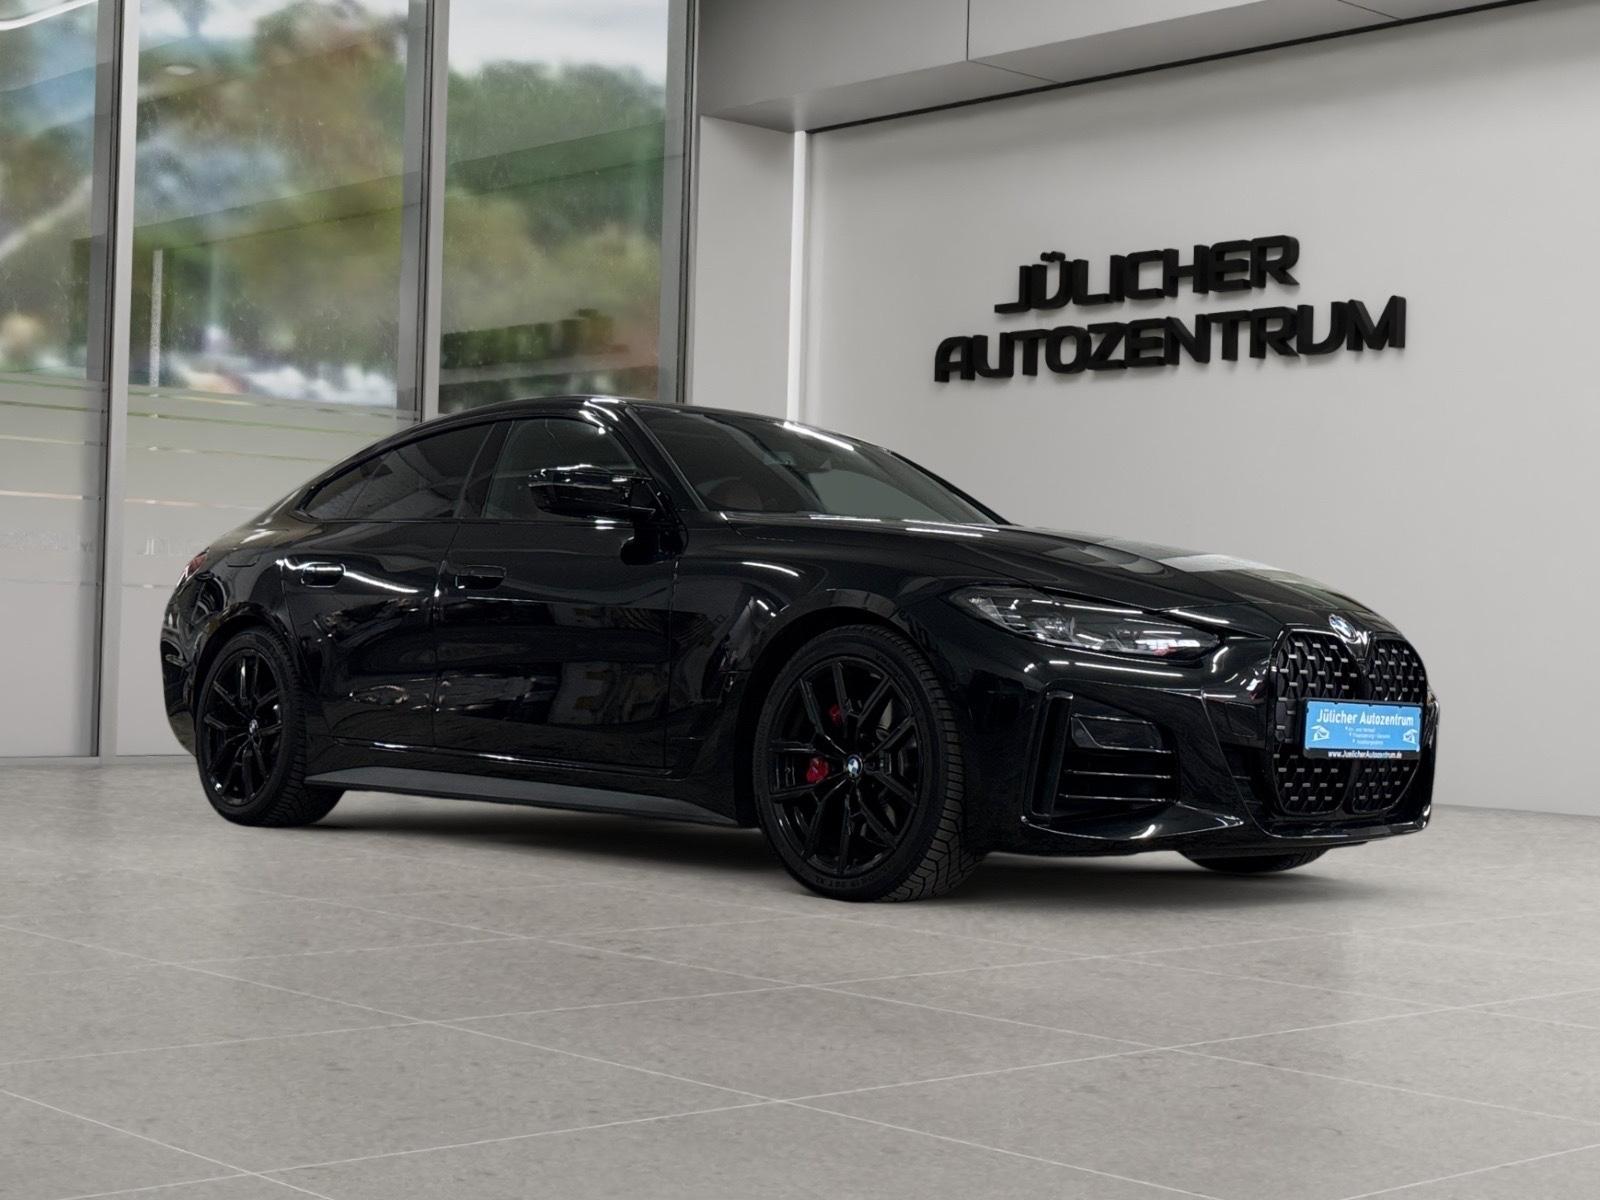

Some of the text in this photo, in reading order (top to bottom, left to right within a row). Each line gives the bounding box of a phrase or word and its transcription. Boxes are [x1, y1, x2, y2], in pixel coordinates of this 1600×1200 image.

[994, 235, 1300, 314] JÜLICHER
[935, 295, 1407, 382] AUTOZENTRUM
[1317, 709, 1414, 727] Jülicher Autozentrum
